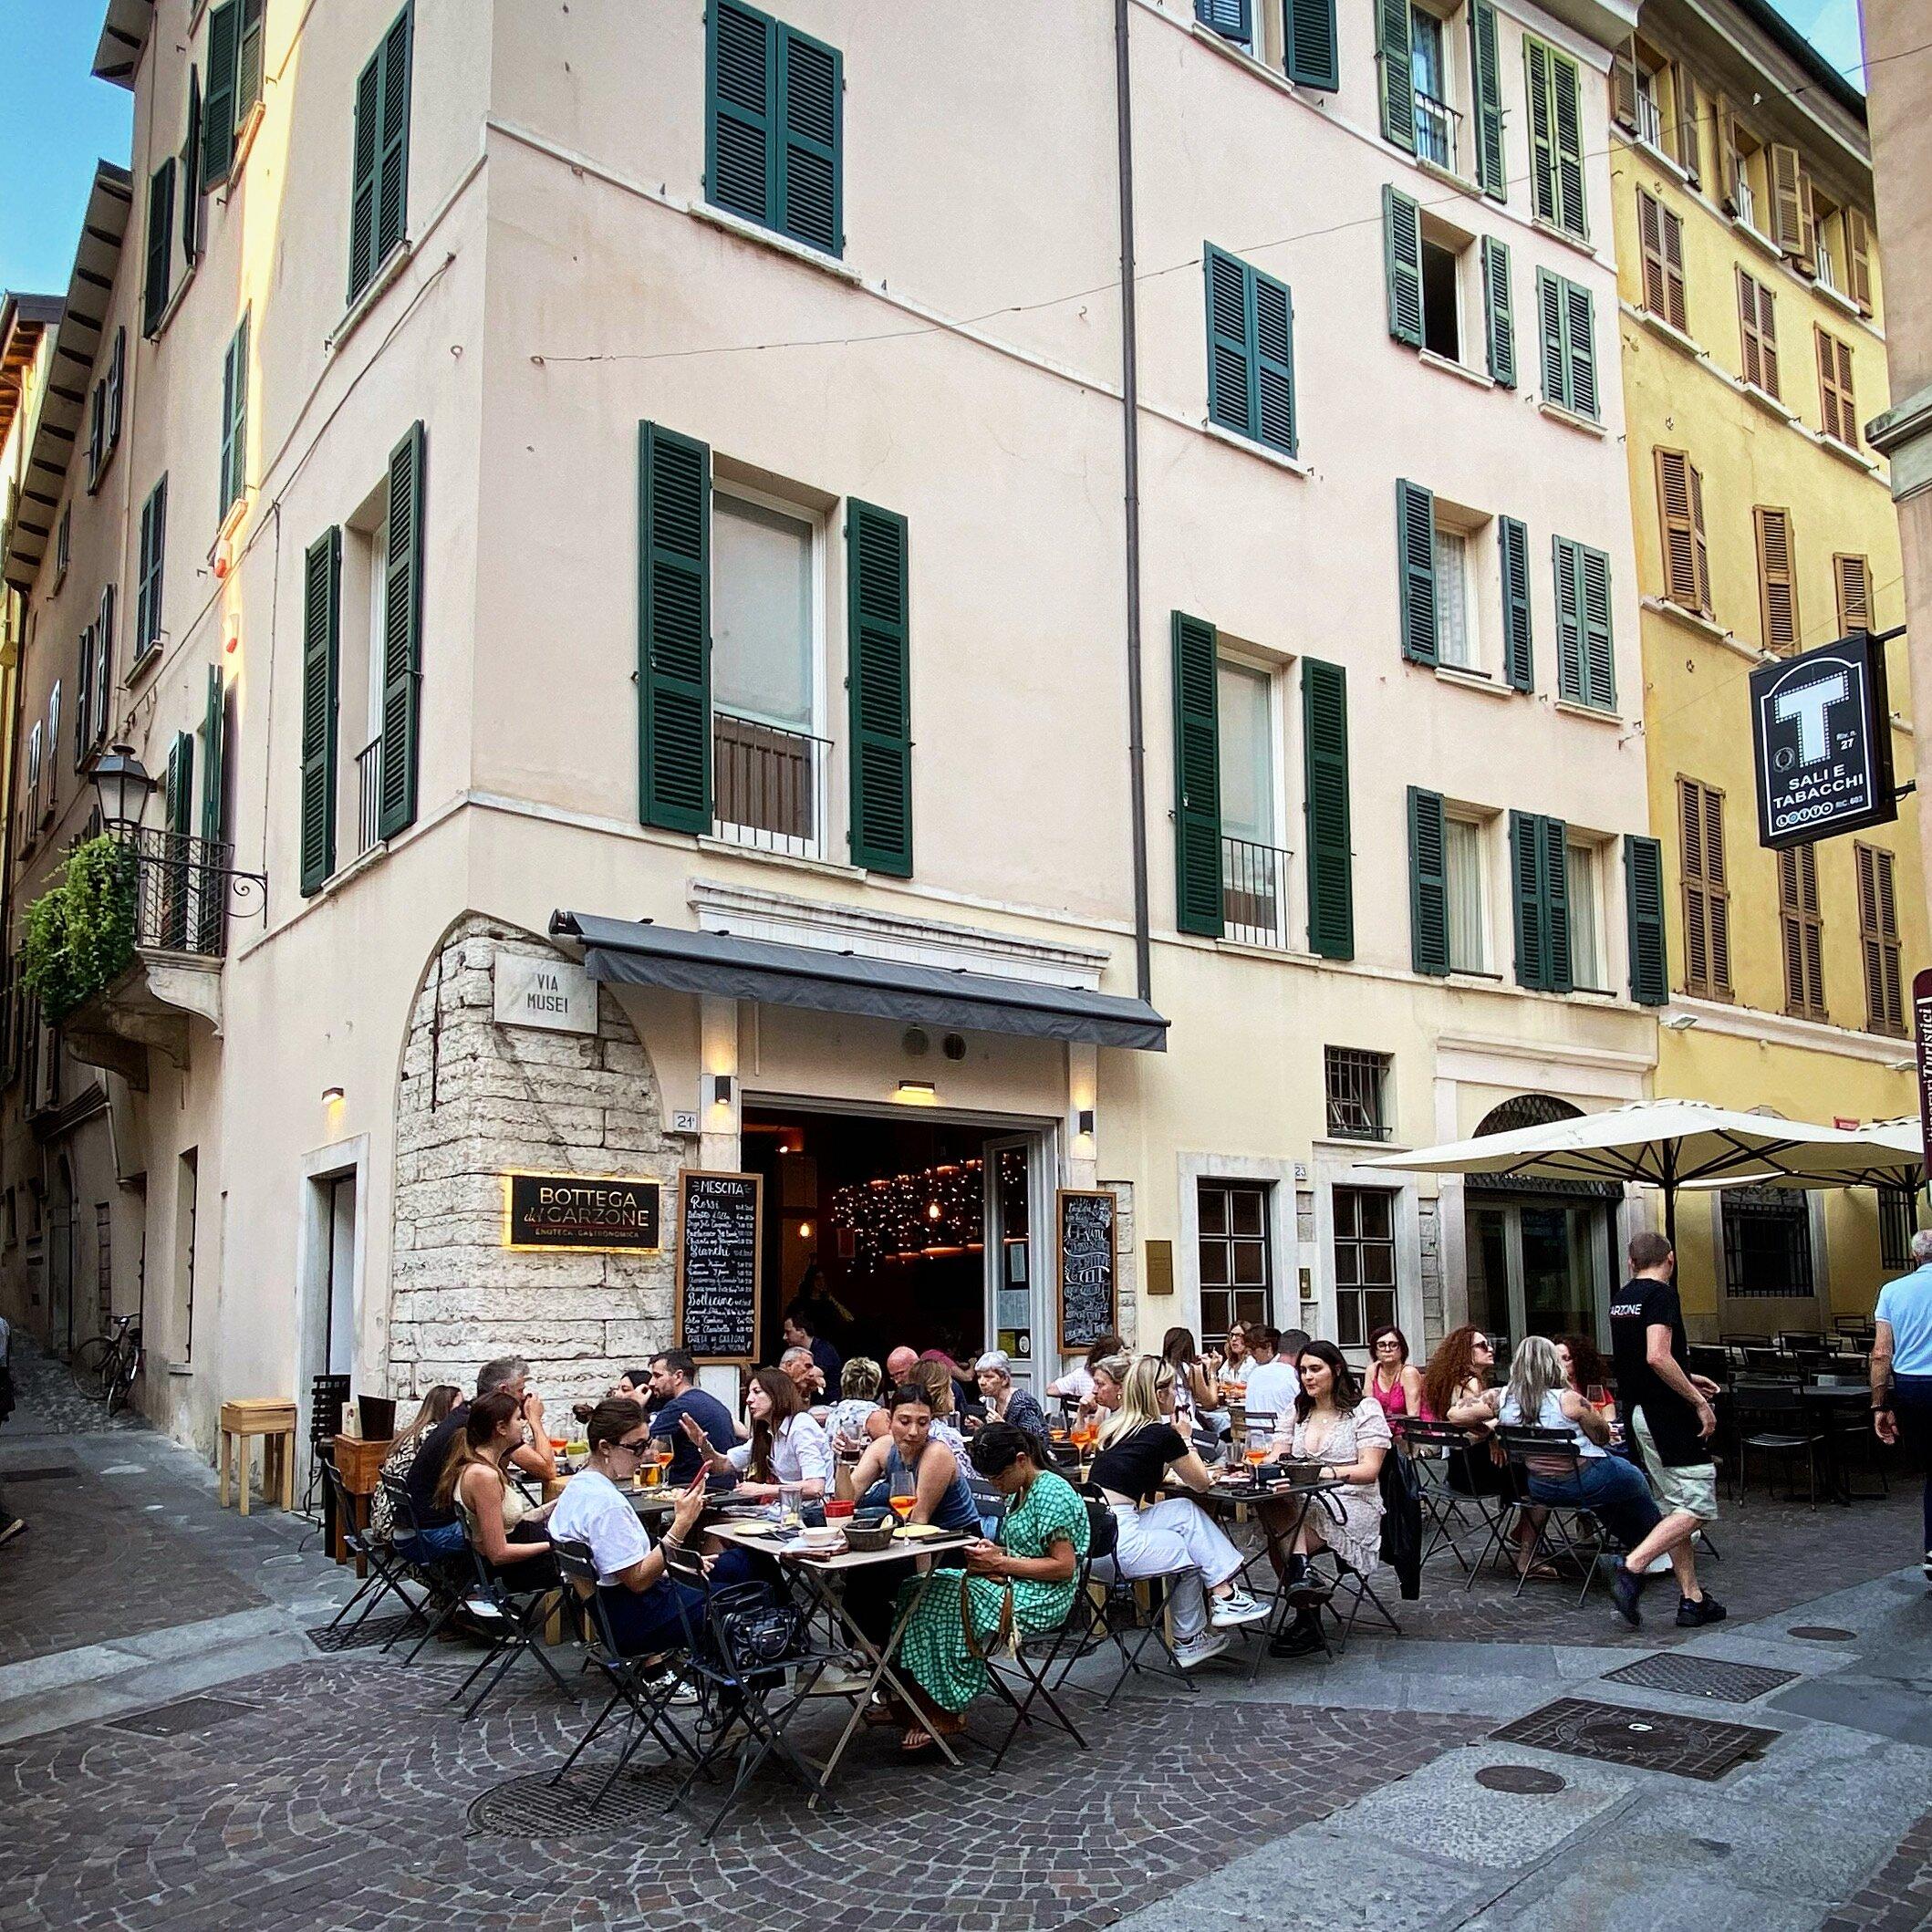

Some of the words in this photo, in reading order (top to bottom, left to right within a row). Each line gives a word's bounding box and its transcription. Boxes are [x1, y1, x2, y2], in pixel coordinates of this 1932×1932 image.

[1777, 673, 1846, 764] T
[1841, 738, 1854, 751] 27
[1788, 769, 1829, 791] SALI
[1833, 763, 1845, 778] E
[1772, 773, 1864, 810] TABACCHI
[1776, 801, 1833, 828] LOTTO
[536, 973, 558, 992] VIA
[526, 992, 568, 1013] MUSEI
[539, 1187, 638, 1209] BOTTEGA
[700, 1180, 744, 1195] MESCITA
[546, 1206, 649, 1228] GARZONE
[535, 1228, 574, 1237] ENOTECA
[577, 1230, 640, 1239] GASTRONOMICA
[690, 1244, 731, 1259] Bianchi
[687, 1293, 734, 1307] Bollicine
